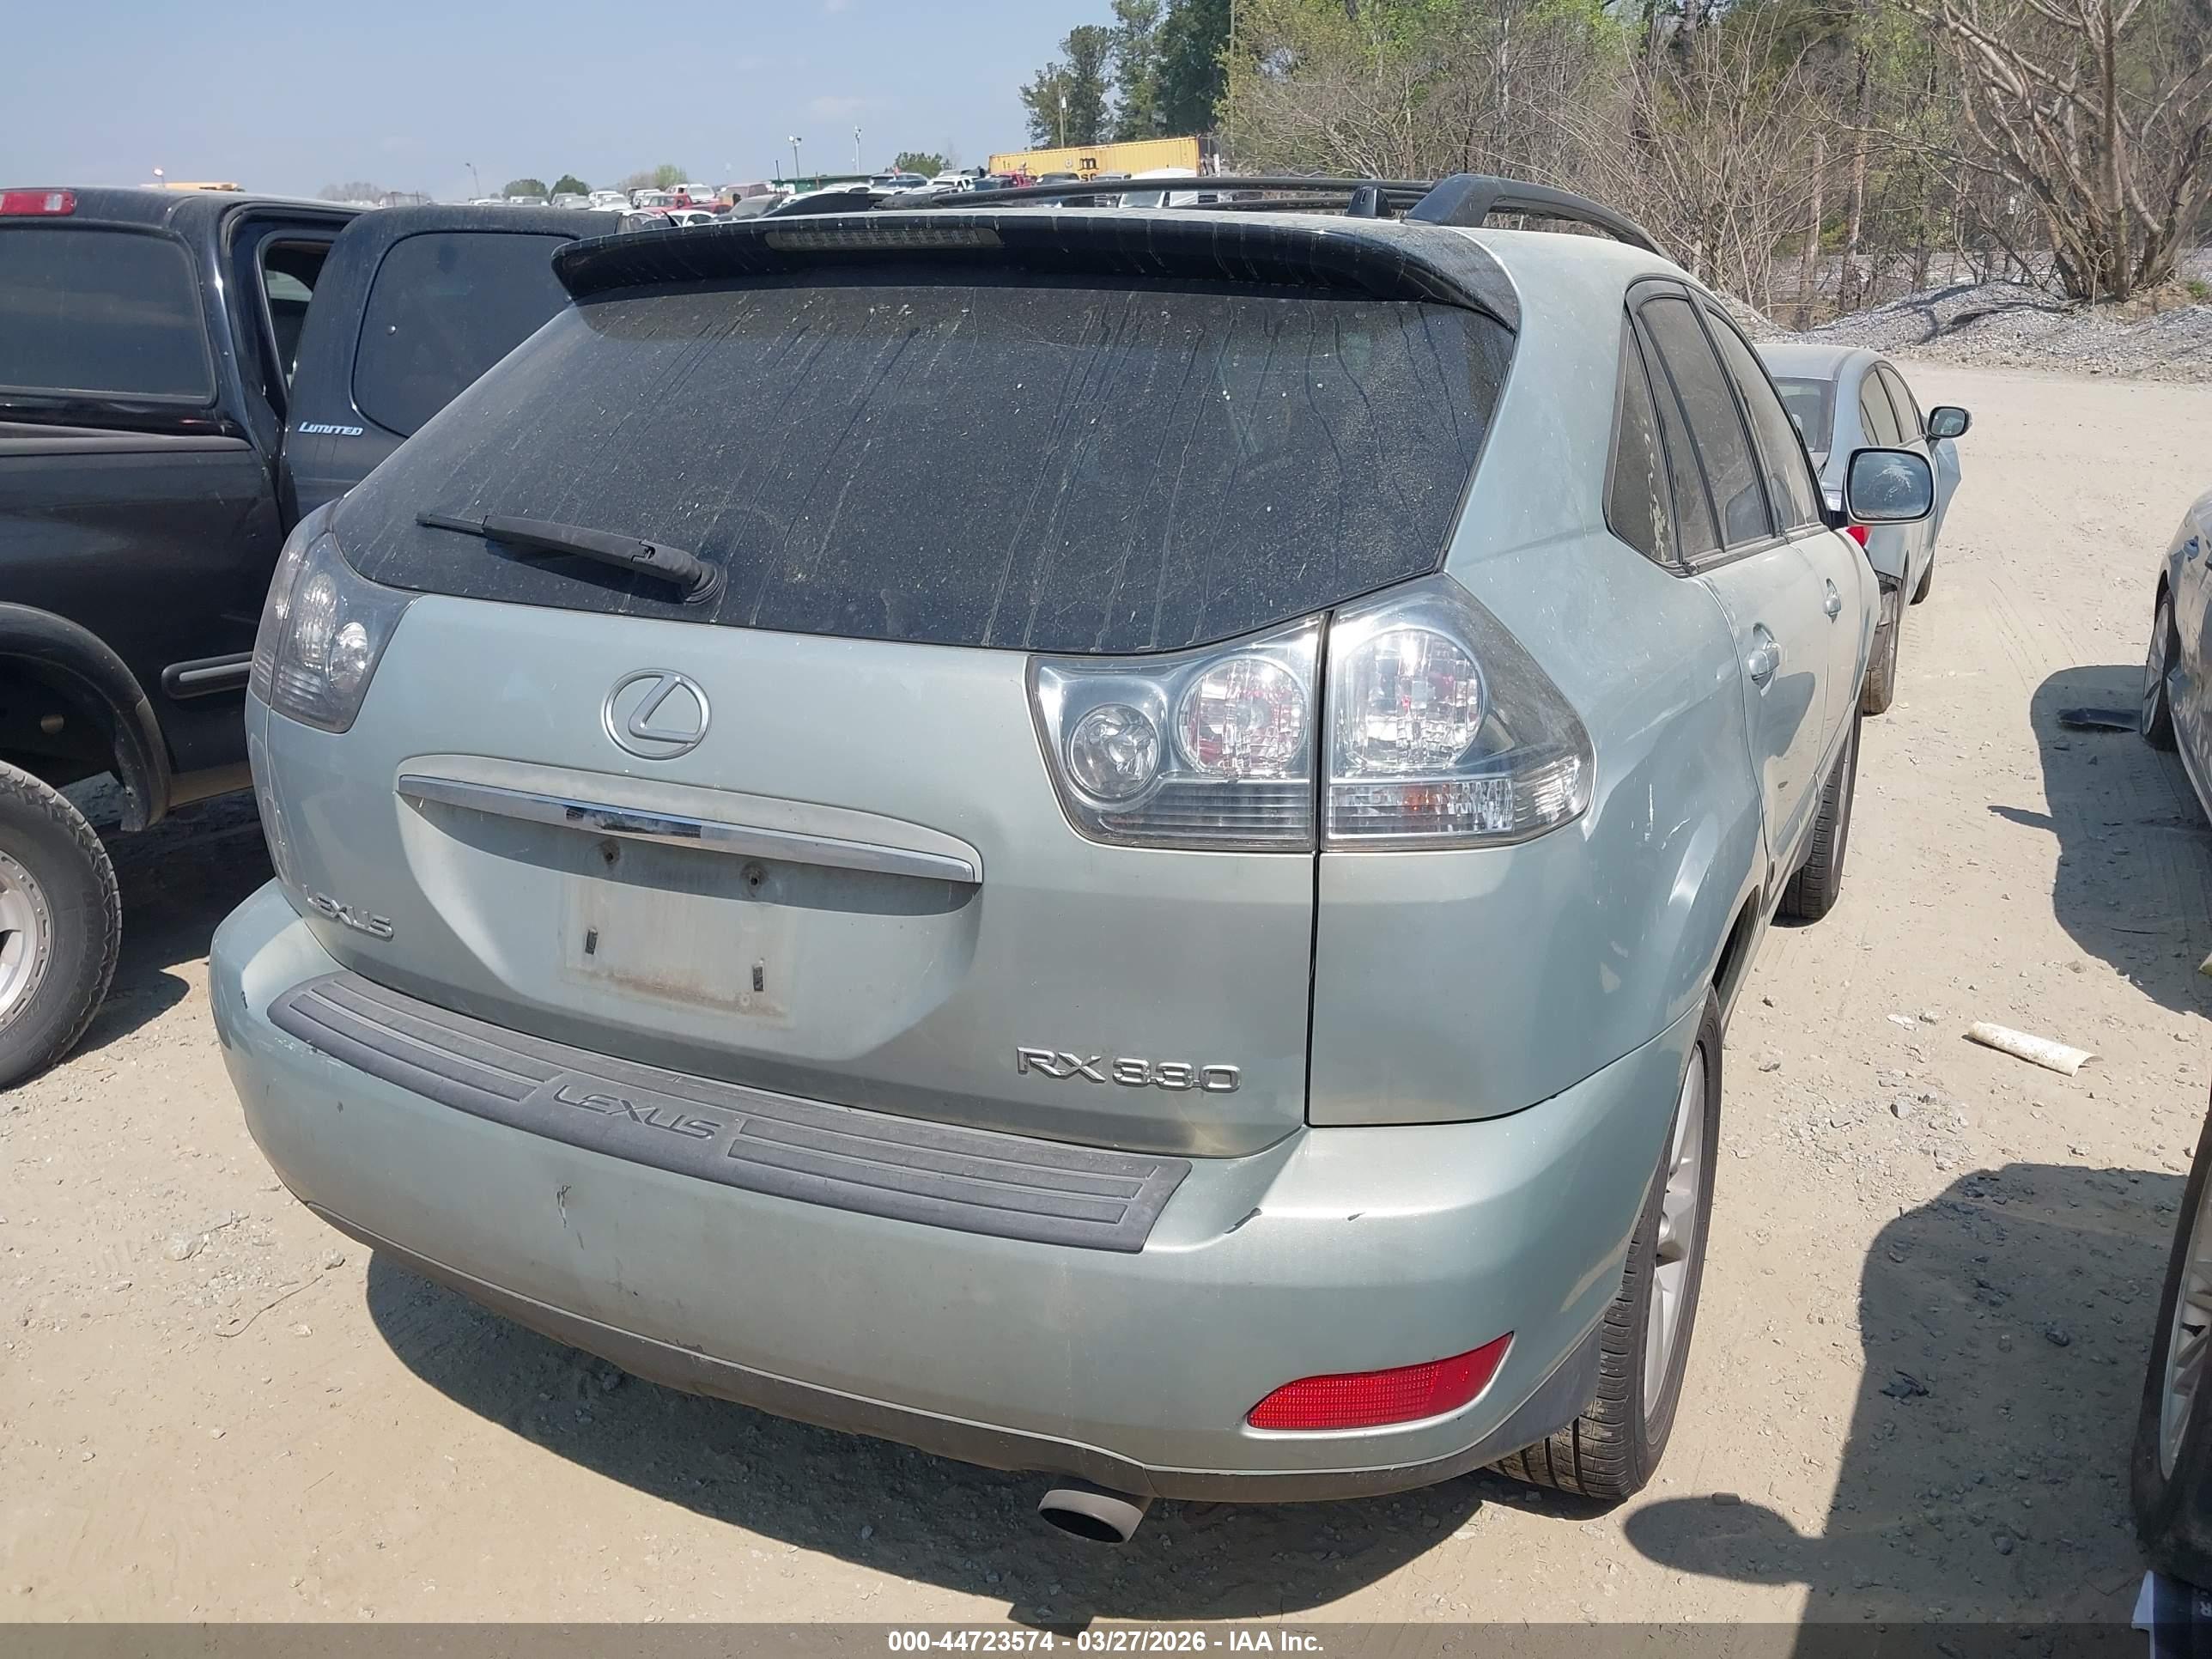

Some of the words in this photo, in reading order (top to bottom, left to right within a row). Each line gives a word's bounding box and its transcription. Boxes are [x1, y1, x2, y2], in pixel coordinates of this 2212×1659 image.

[298, 422, 363, 436] LIMITED
[302, 884, 394, 940] LEXUS
[1017, 1046, 1106, 1084] RX
[1113, 1057, 1242, 1094] 330
[553, 1085, 722, 1139] LEXUS
